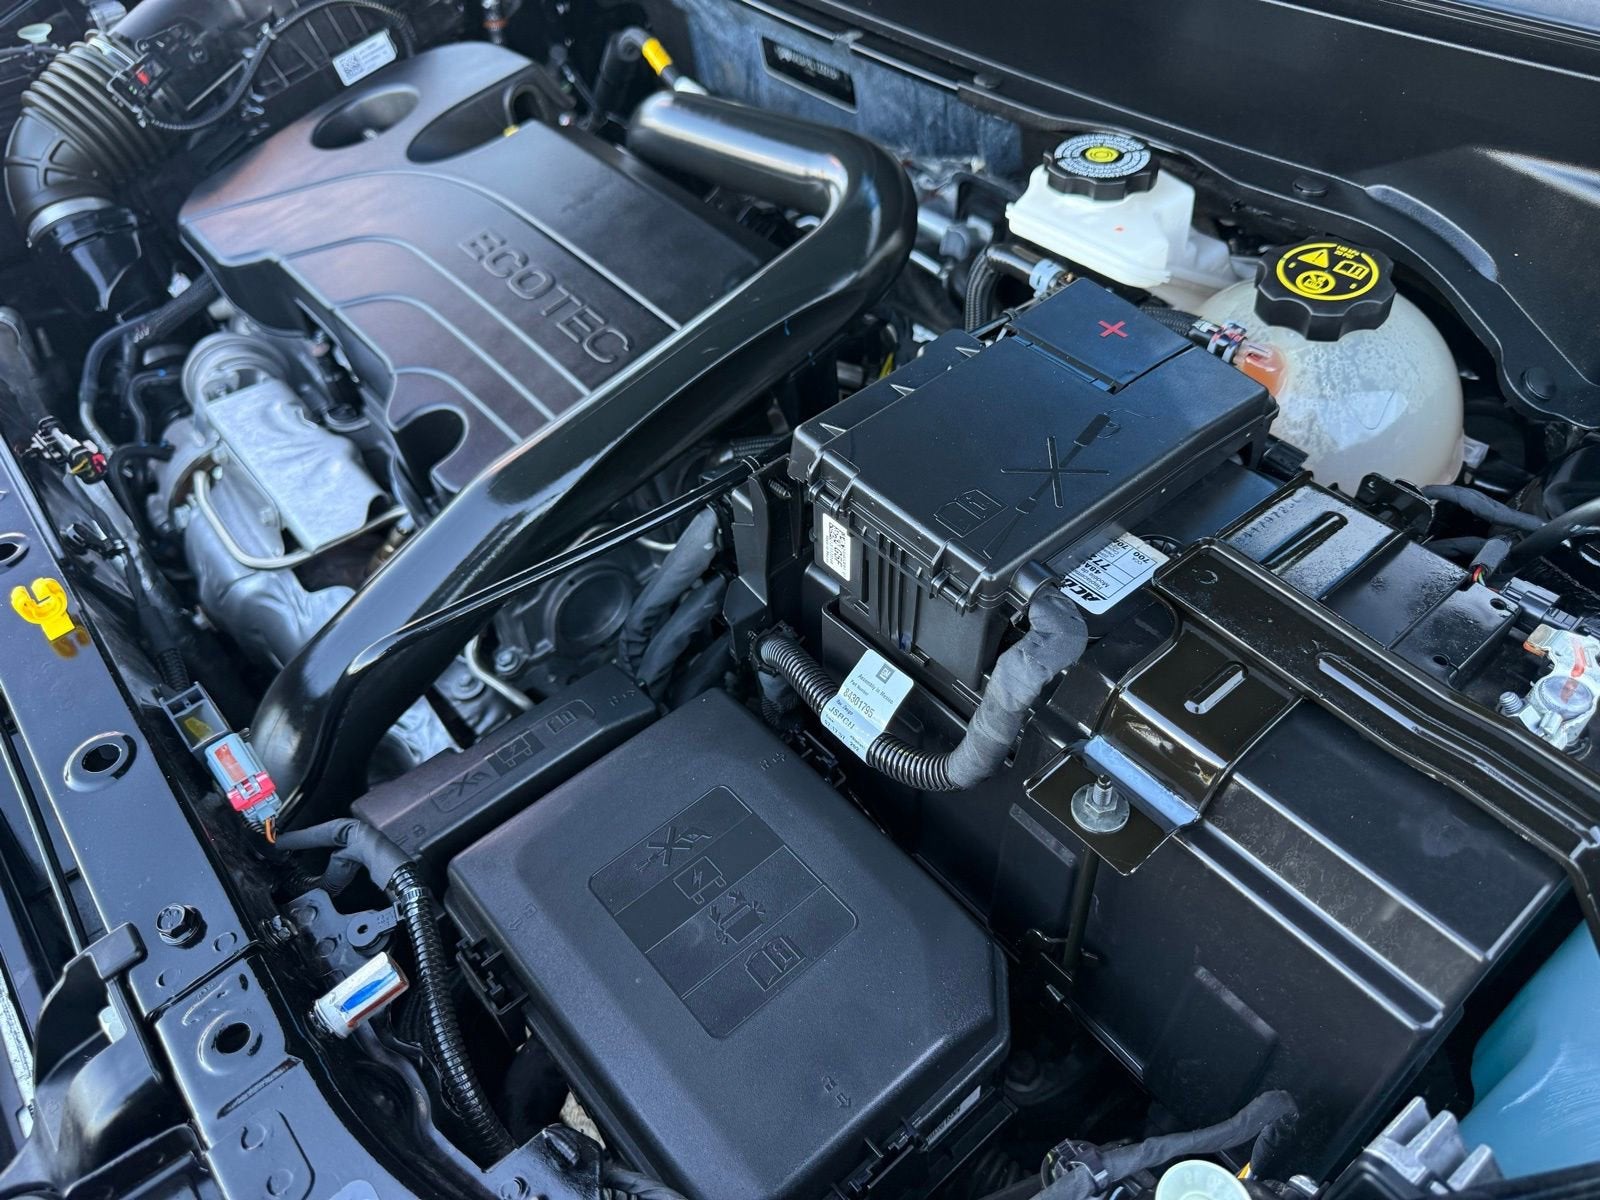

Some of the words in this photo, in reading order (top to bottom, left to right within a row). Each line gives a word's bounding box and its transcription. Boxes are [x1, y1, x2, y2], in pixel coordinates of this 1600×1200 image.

[458, 229, 634, 363] ECOTEC
[1134, 551, 1150, 564] 700
[843, 687, 876, 718] 84301795
[880, 691, 895, 704] Mexico
